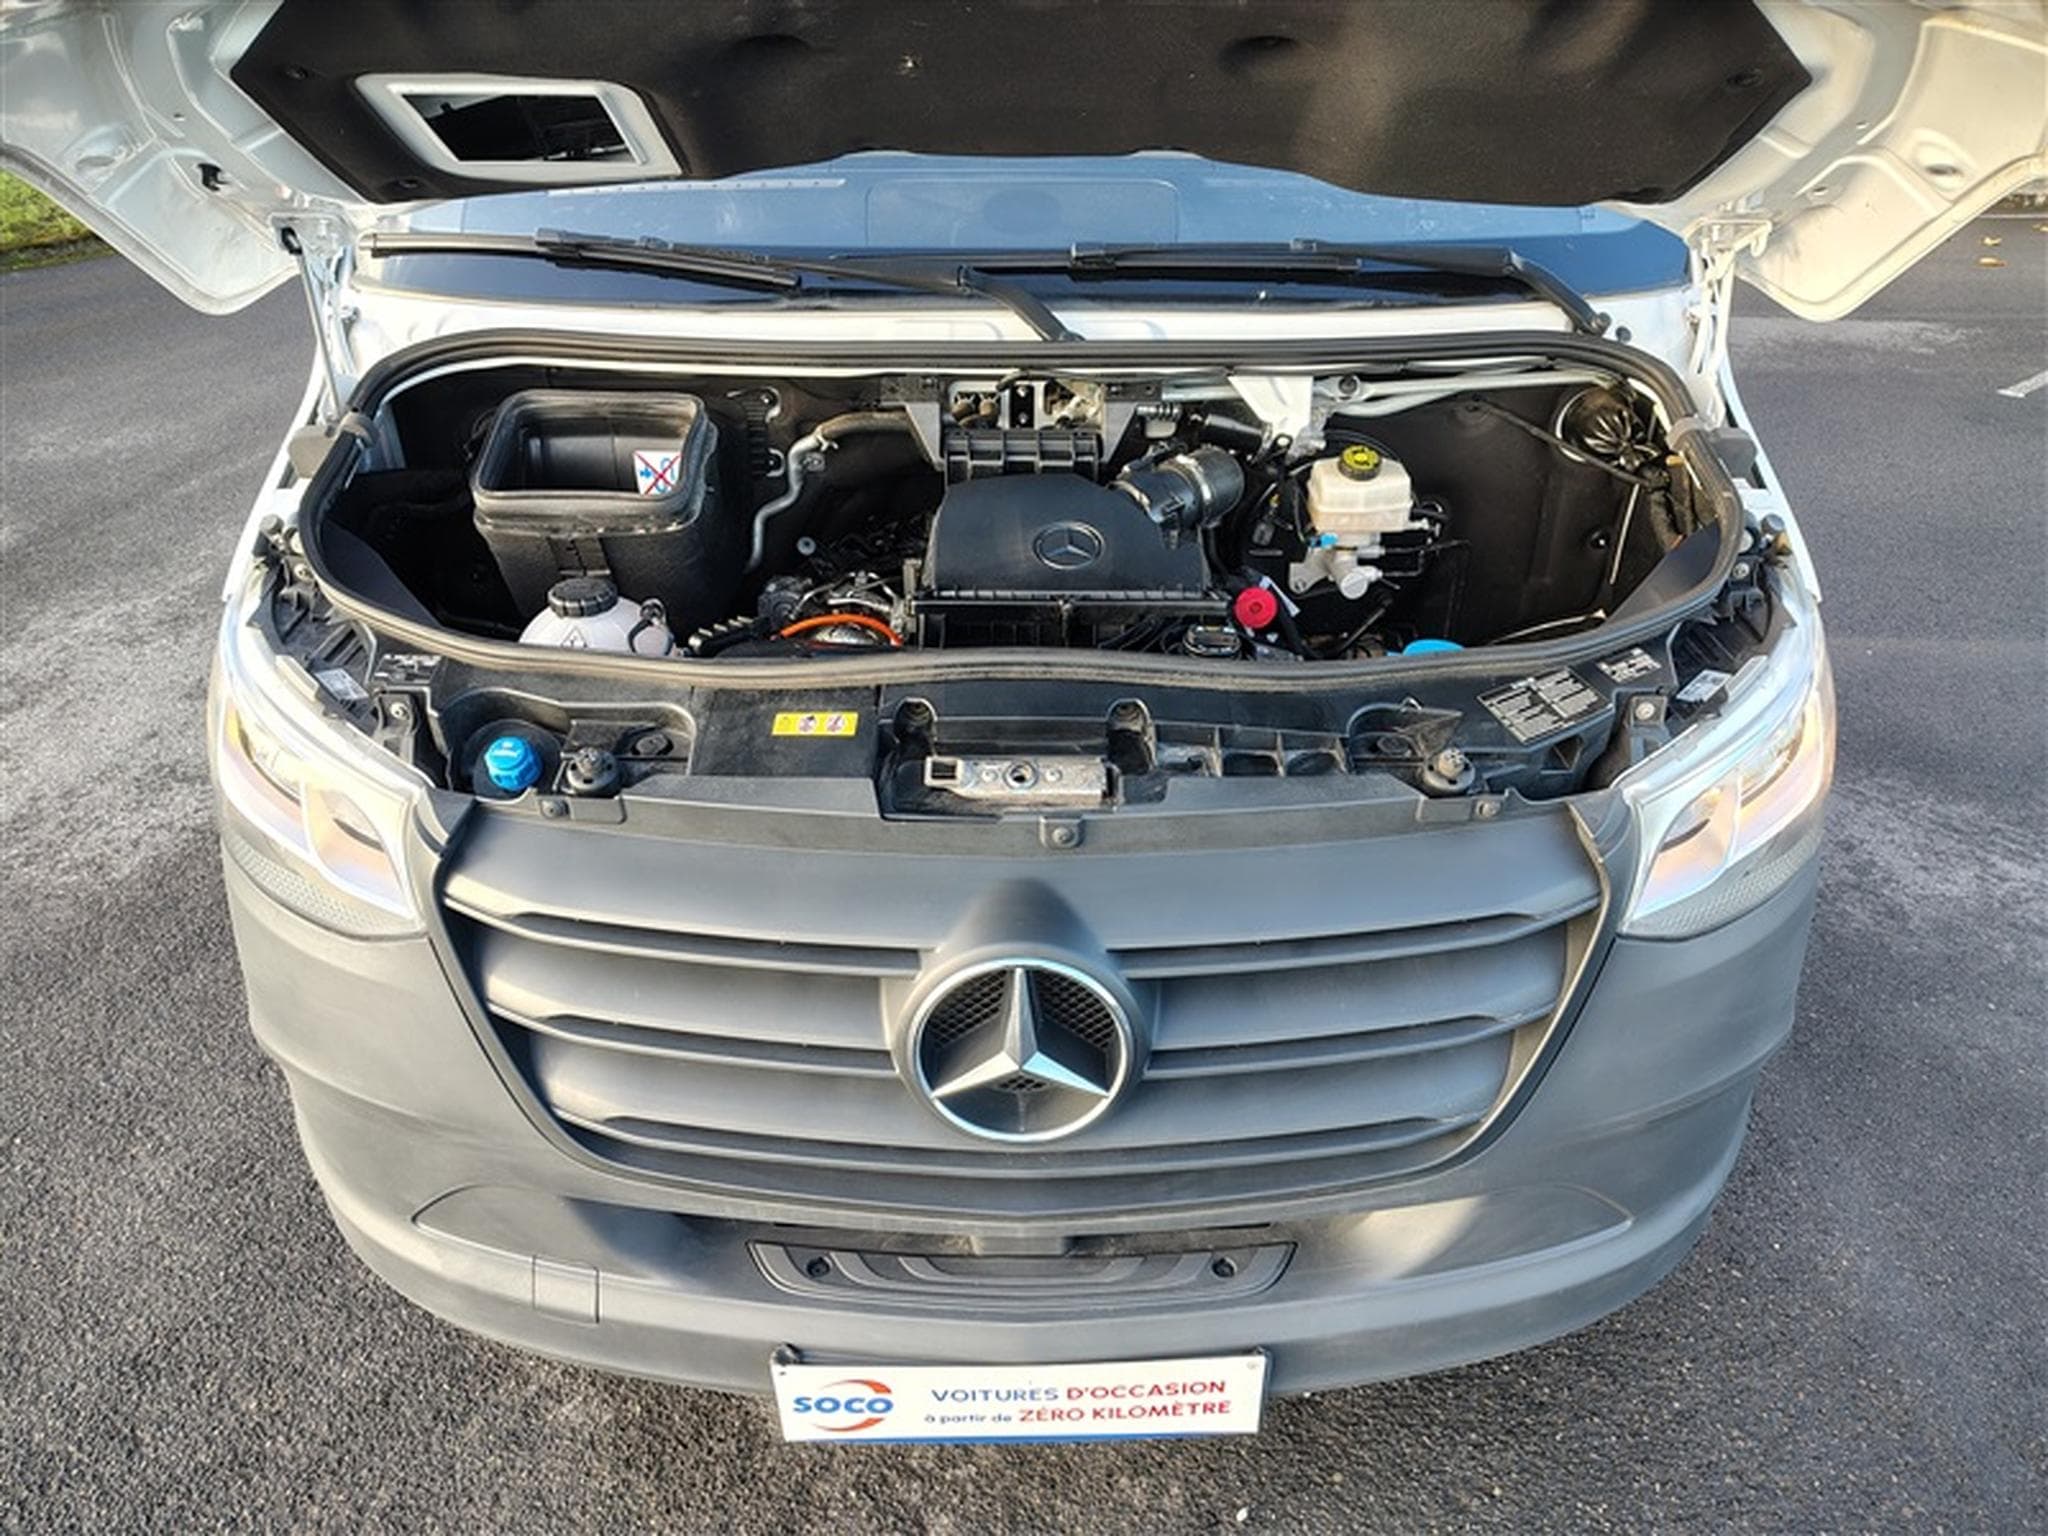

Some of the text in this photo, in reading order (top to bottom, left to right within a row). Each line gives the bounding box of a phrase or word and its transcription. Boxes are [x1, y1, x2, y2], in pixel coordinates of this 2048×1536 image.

[931, 1380, 1226, 1402] VOITURES D'OCCASION
[793, 1397, 894, 1414] SOCO
[939, 1413, 987, 1425] partir
[992, 1413, 1012, 1423] de
[1018, 1405, 1085, 1422] ZÉRO
[1092, 1400, 1231, 1420] KILOMÈTRE
